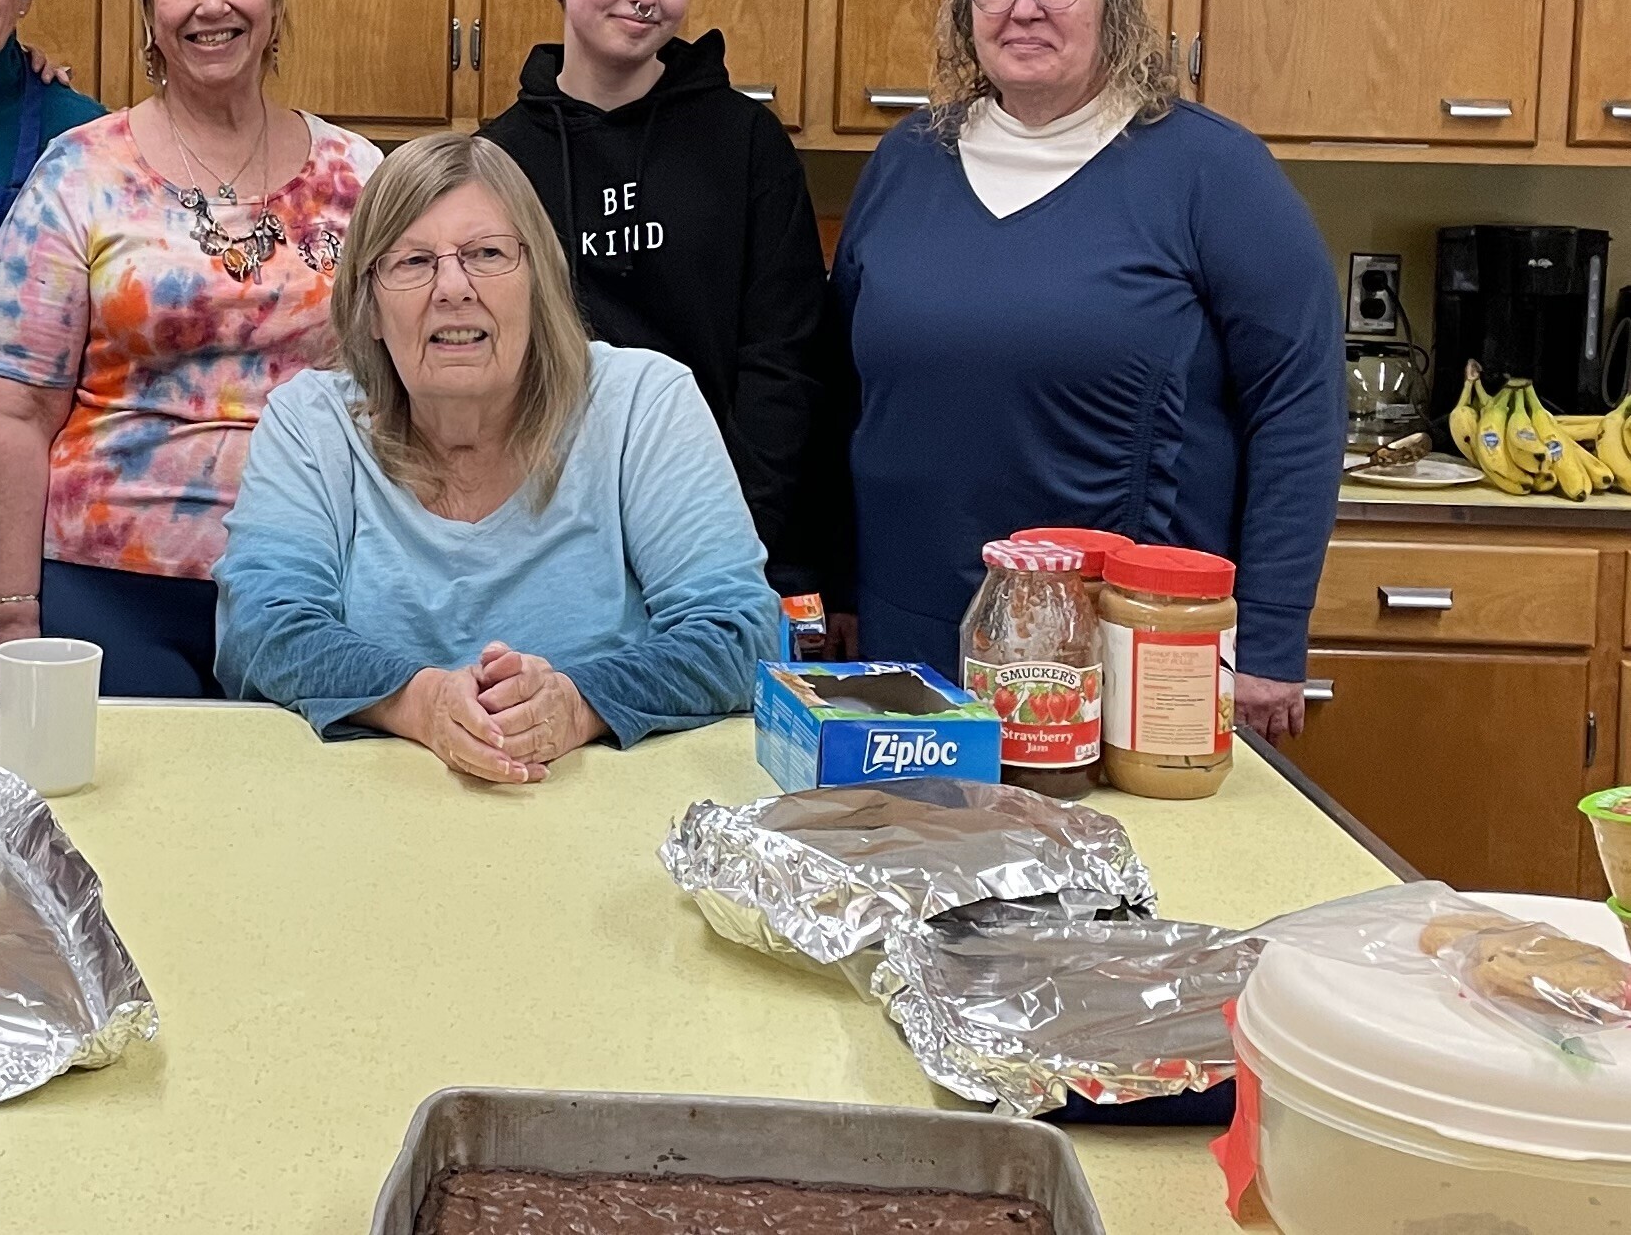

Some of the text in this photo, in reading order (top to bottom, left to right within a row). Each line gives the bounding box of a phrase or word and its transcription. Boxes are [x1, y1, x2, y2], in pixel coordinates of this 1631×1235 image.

[602, 182, 637, 216] BE
[581, 221, 664, 257] KIND
[1001, 726, 1074, 745] Strawberry
[1025, 742, 1049, 754] Jam
[872, 734, 958, 774] Ziploc
